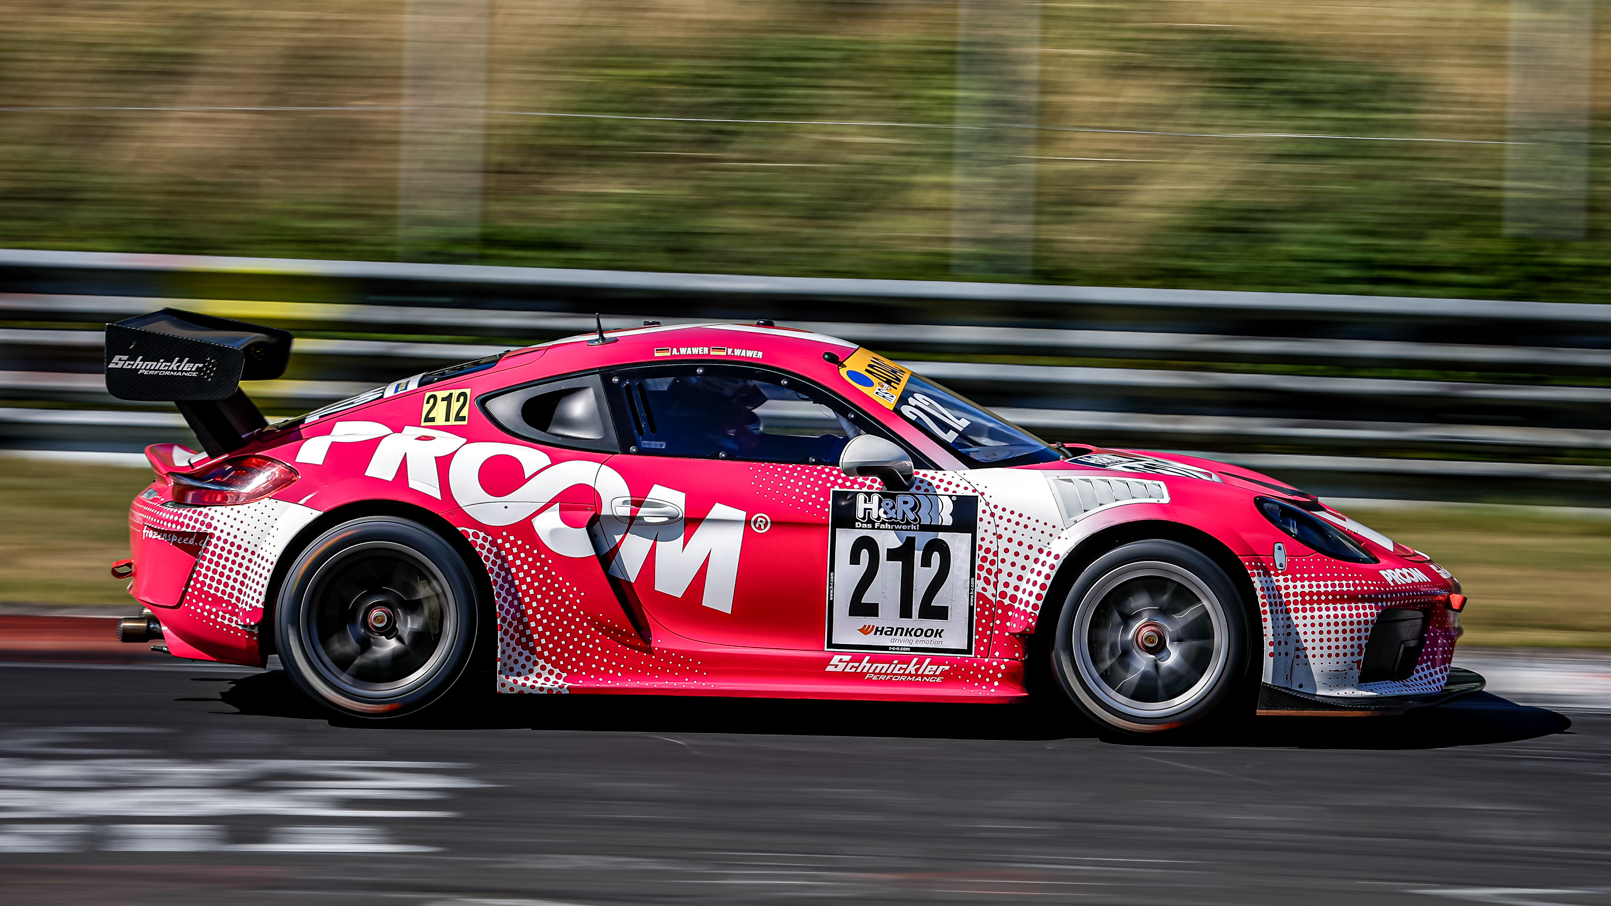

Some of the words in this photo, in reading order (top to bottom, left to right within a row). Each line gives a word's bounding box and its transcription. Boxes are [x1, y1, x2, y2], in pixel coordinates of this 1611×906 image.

[672, 347, 709, 355] A.WAWER
[727, 348, 763, 358] V.WAWER
[108, 355, 203, 371] Schmickler
[137, 369, 199, 377] PERFORMANCE
[423, 391, 468, 423] 212
[900, 393, 971, 443] 212
[874, 522, 920, 531] Fahrwerk!
[142, 525, 204, 547] frozenspeed.c
[848, 535, 952, 620] 212
[890, 637, 914, 646] driving
[915, 638, 943, 646] emotion
[825, 655, 951, 675] Schmickler
[864, 673, 944, 683] PERFORMANCE
